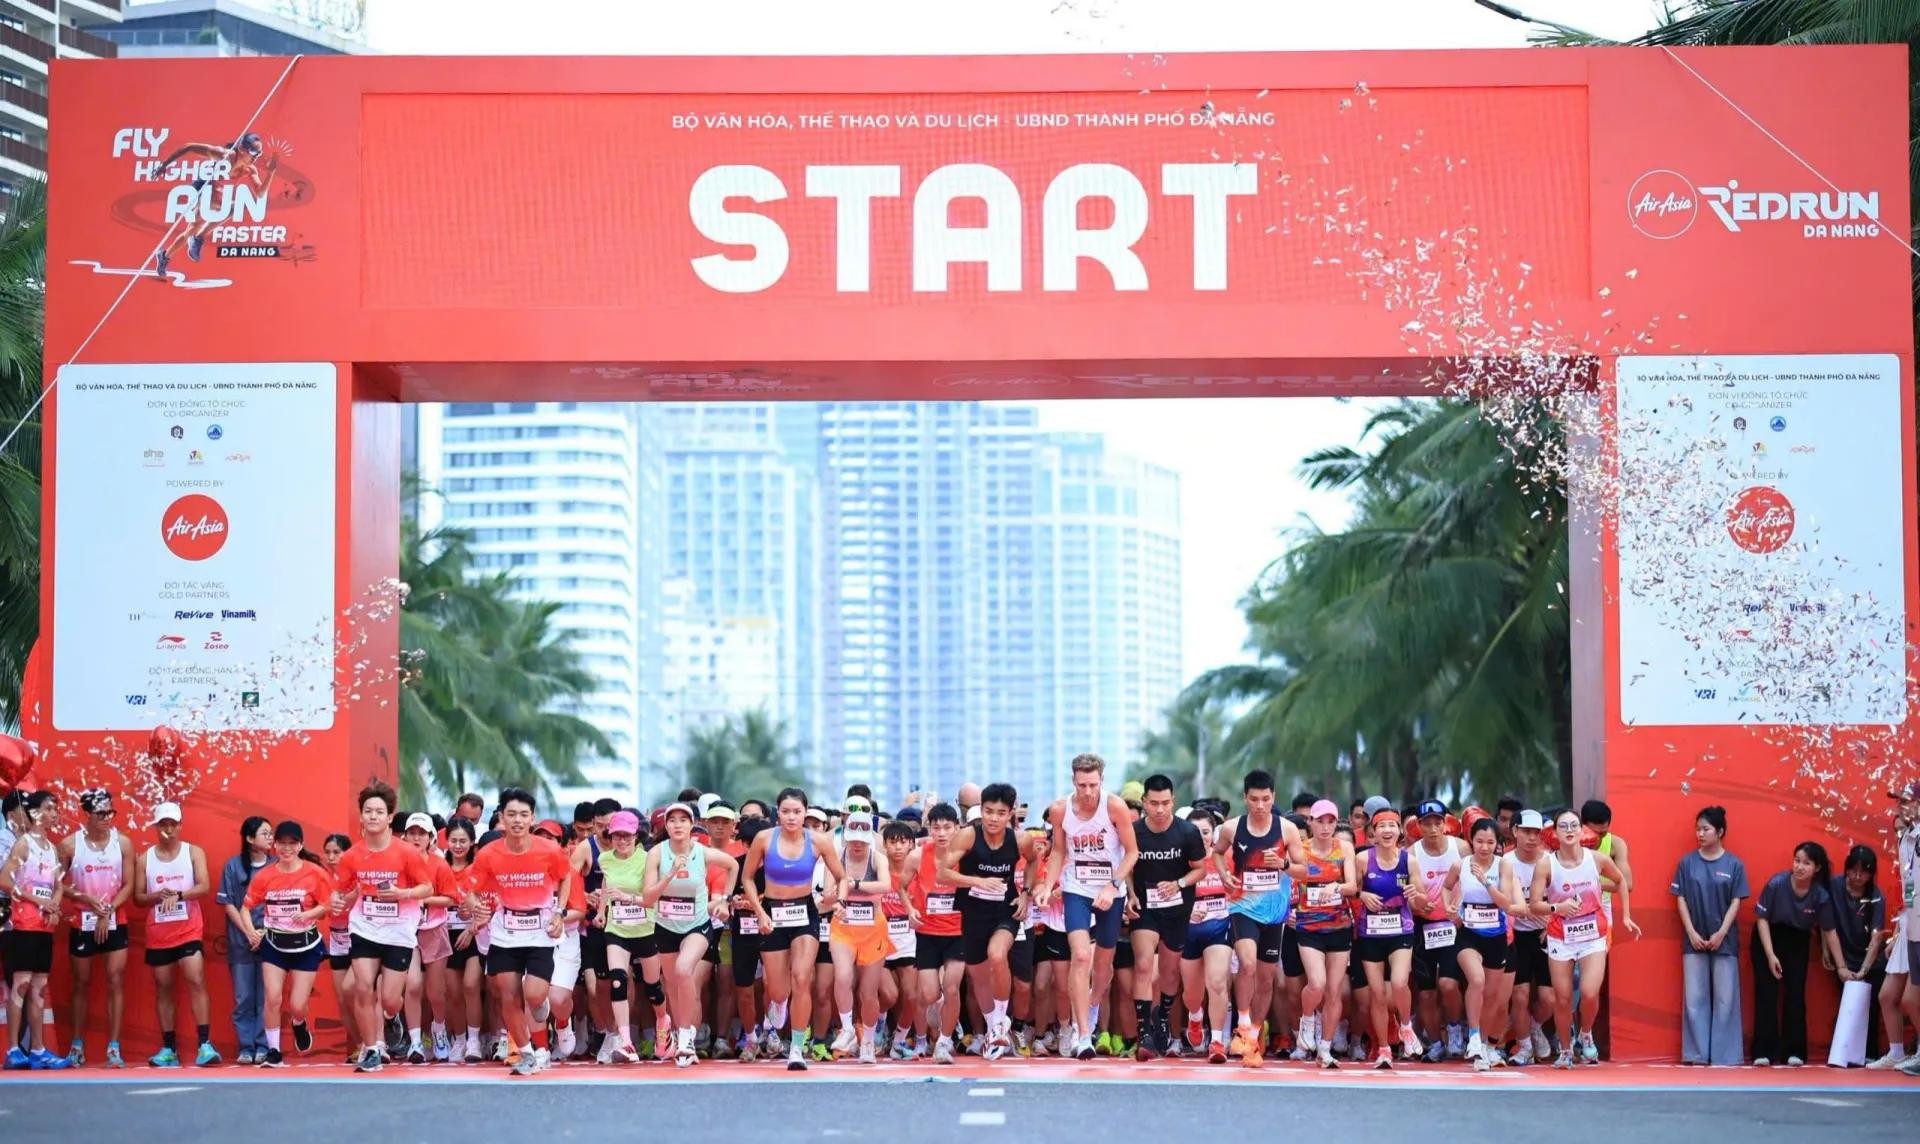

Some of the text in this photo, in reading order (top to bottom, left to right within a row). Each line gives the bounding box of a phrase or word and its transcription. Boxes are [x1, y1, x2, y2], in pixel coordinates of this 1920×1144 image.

[840, 114, 890, 129] THAO
[924, 114, 952, 129] DU
[958, 114, 998, 132] LỊCH
[1015, 114, 1069, 129] UBND
[112, 128, 169, 157] FLY
[134, 160, 232, 182] HIGHER
[164, 184, 269, 224] RUN
[212, 225, 287, 243] FASTER
[688, 163, 1258, 292] START
[1803, 223, 1880, 238] DA NANG
[220, 246, 276, 257] DA NANG
[166, 480, 224, 488] POWERED BY
[221, 609, 256, 619] Vinamilk
[1138, 847, 1181, 860] amazfit
[978, 863, 1011, 873] amazfit
[1427, 929, 1453, 939] PACER
[1567, 923, 1594, 933] PACER
